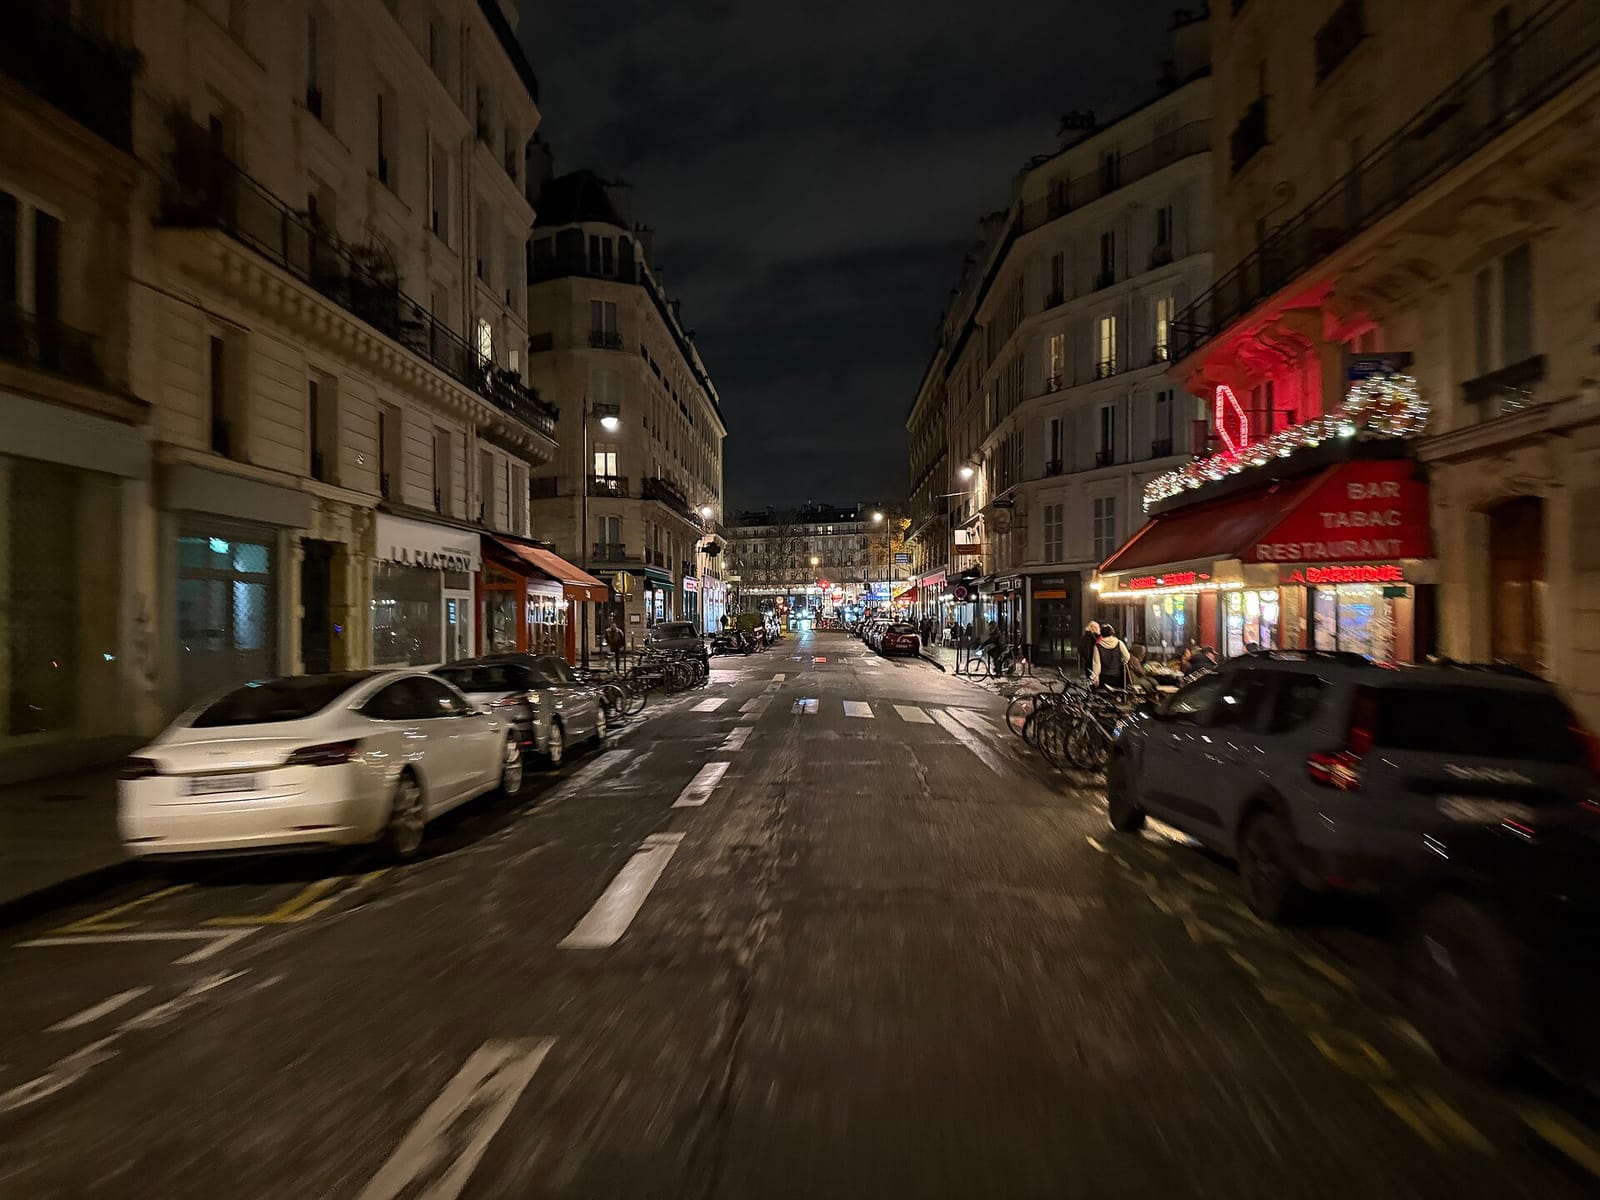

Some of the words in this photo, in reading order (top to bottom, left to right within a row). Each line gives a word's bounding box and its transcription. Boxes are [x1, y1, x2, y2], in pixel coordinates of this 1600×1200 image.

[1347, 481, 1400, 499] BAR
[1320, 510, 1401, 528] TABAC
[1256, 538, 1403, 560] RESTAURANT
[414, 549, 472, 573] FACTORY
[1306, 564, 1404, 583] BARRIQUE
